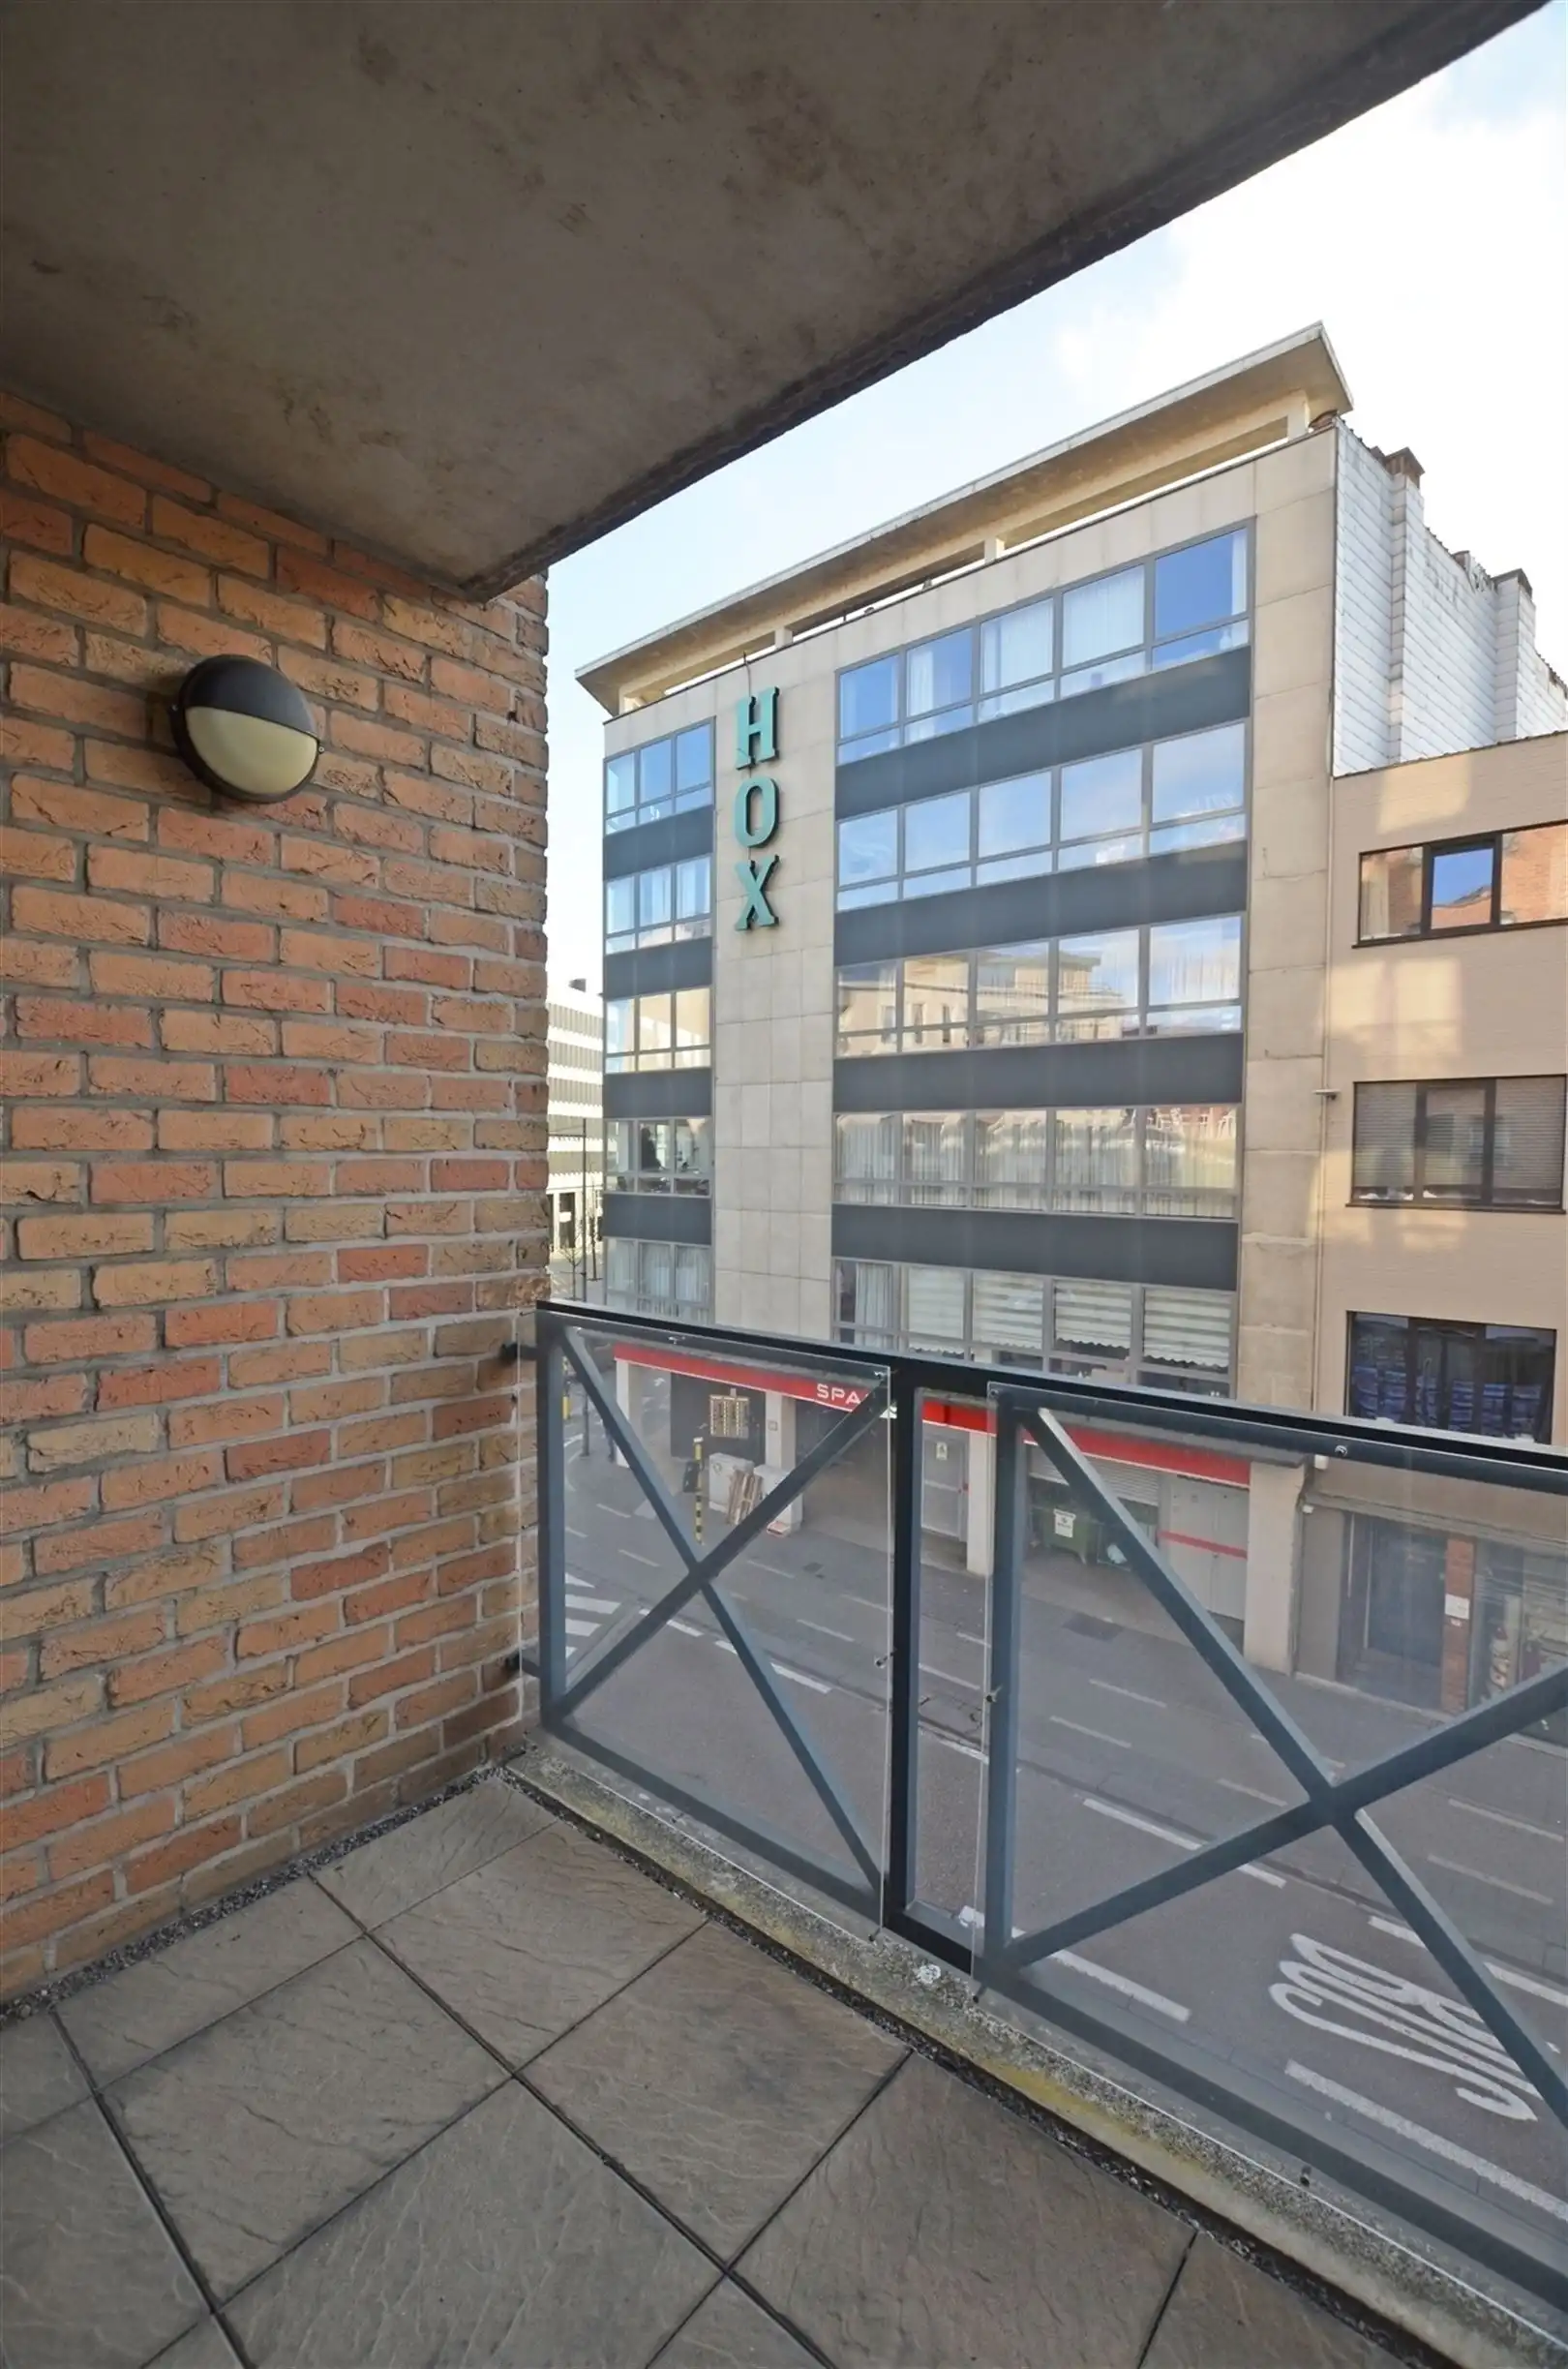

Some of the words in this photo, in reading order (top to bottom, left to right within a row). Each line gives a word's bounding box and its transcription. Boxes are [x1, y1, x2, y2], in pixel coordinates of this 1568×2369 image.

[735, 686, 779, 931] HOX
[816, 1382, 869, 1405] SPA
[1269, 1933, 1559, 2121] BUS
